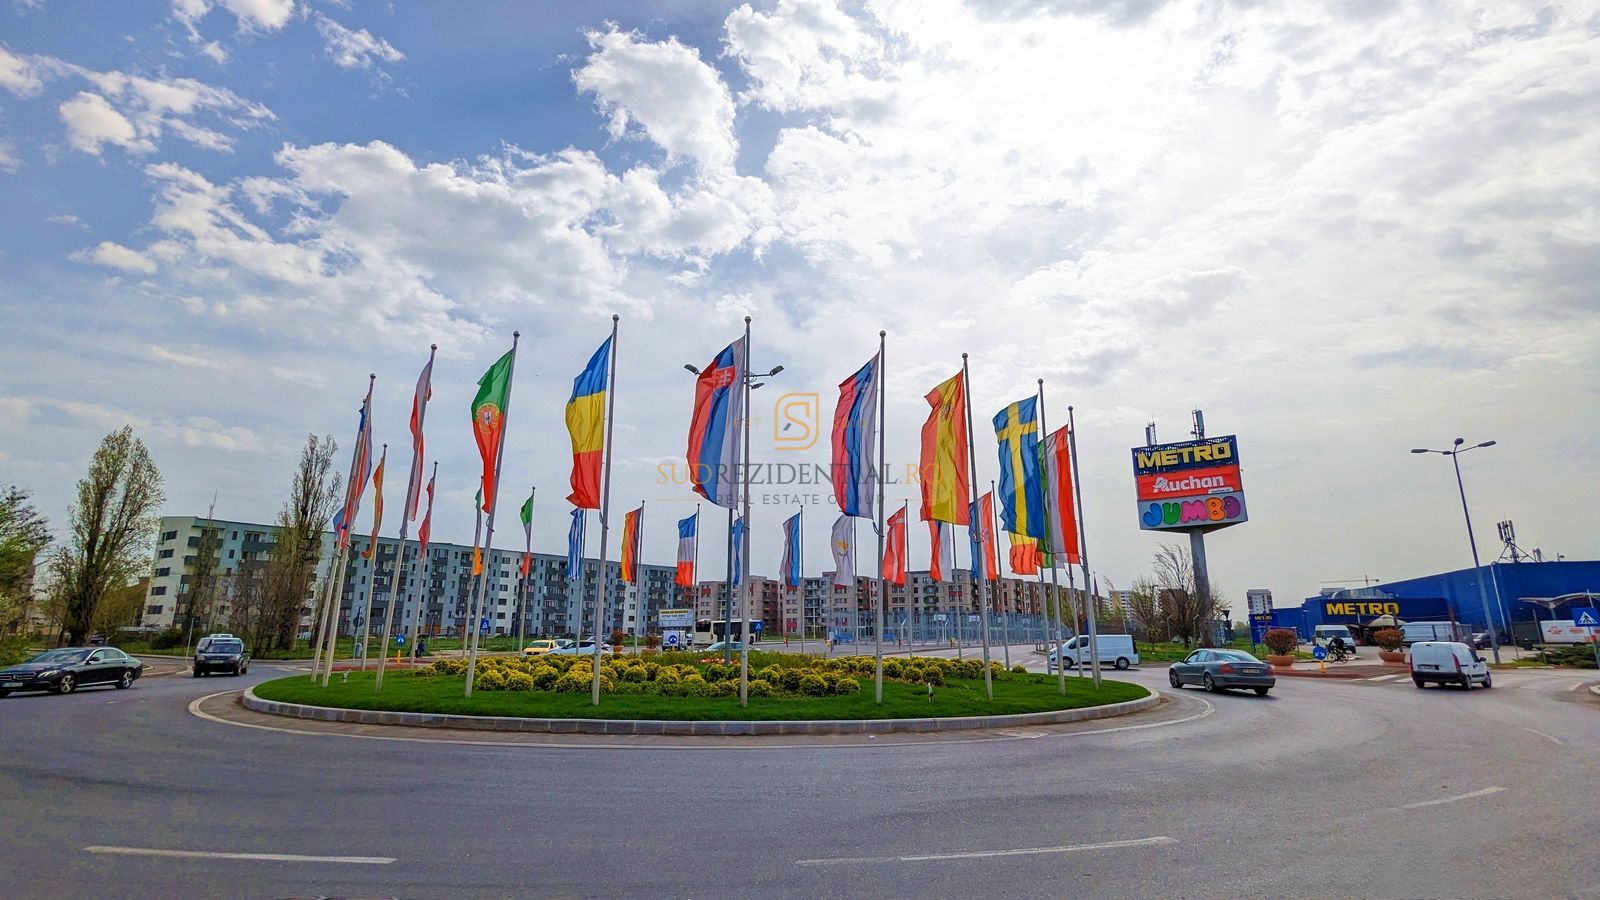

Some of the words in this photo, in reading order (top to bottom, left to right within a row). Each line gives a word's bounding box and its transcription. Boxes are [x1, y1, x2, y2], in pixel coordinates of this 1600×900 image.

[1137, 442, 1232, 469] METRO
[1153, 476, 1224, 493] Auchan
[1143, 495, 1241, 527] JUMBO
[1326, 602, 1400, 616] METRO
